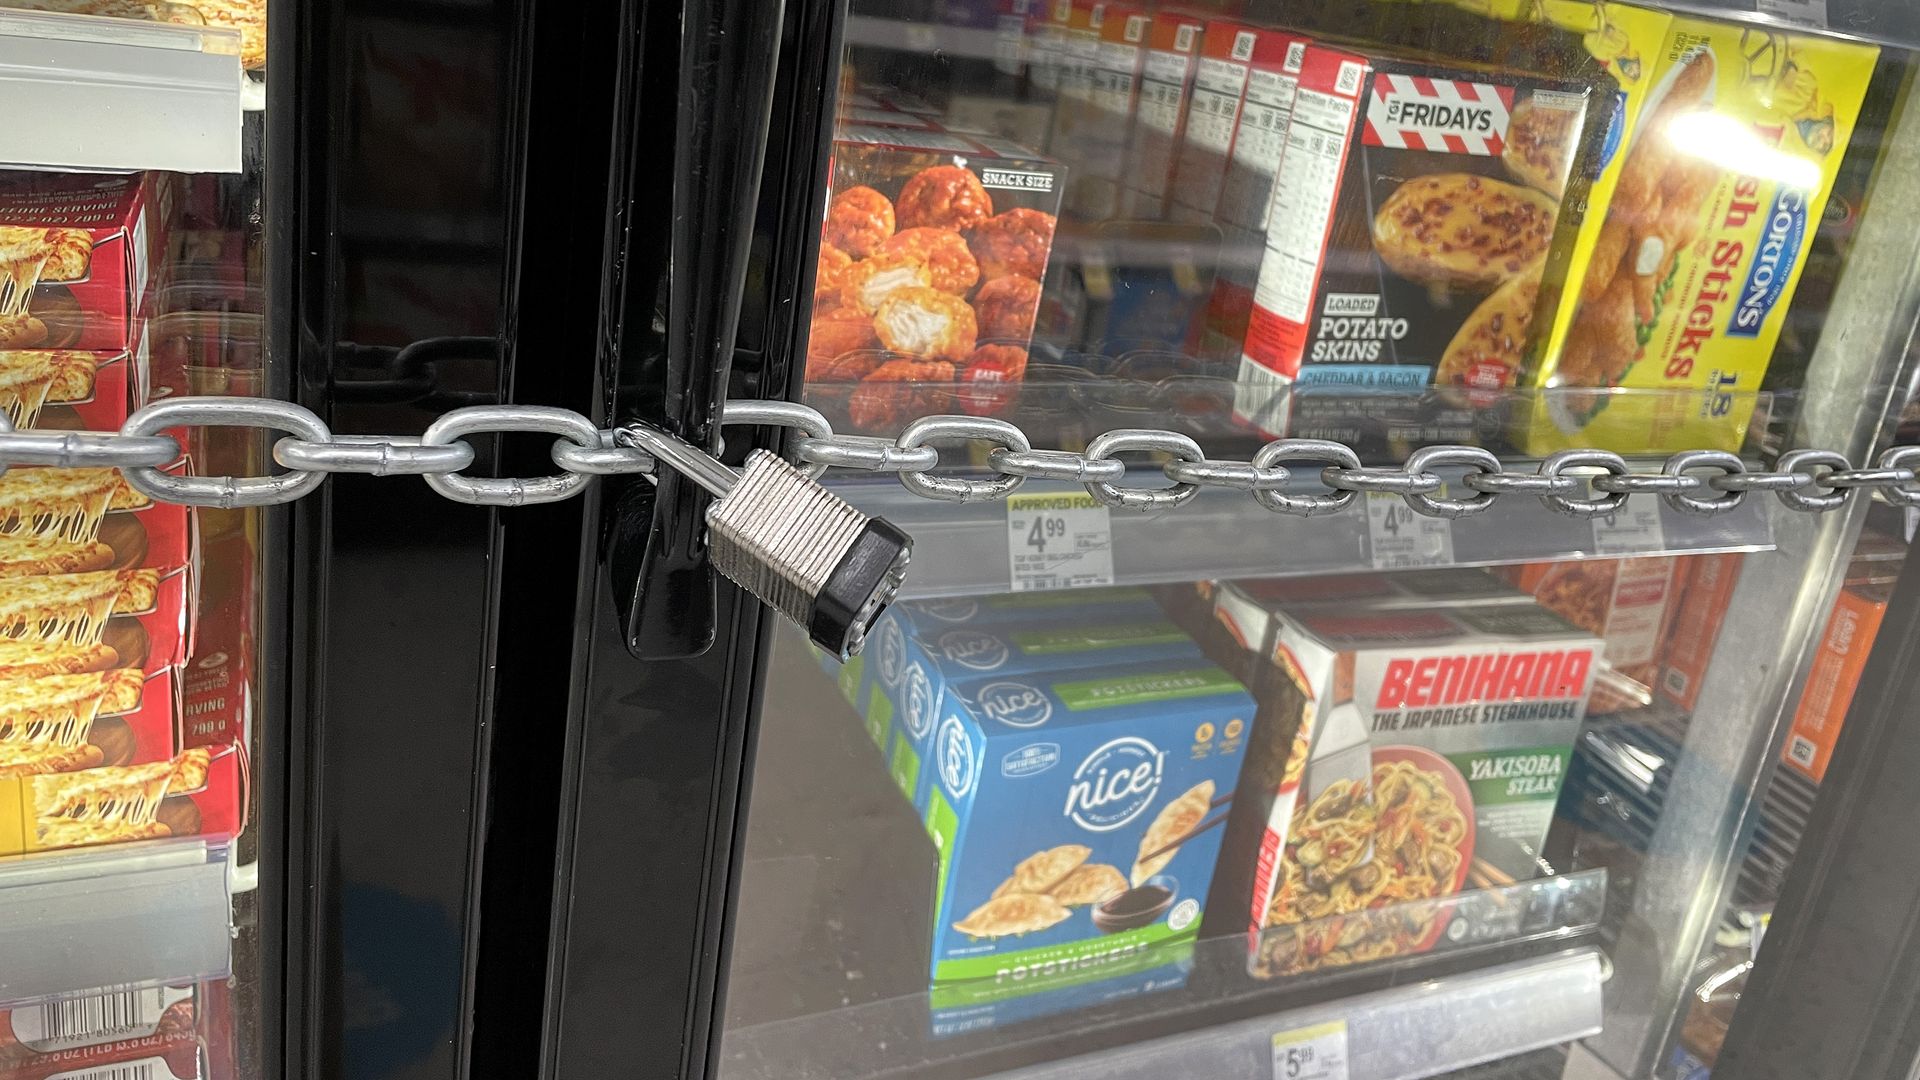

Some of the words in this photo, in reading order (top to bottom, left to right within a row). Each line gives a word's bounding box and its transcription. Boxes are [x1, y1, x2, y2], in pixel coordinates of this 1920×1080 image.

[1386, 99, 1401, 123] TGI
[1400, 101, 1492, 131] FRIDAYS
[982, 172, 1025, 186] SNACK
[1025, 175, 1053, 188] SIZE
[52, 201, 118, 213] SERVING
[1328, 297, 1376, 312] LOADED
[1664, 239, 1744, 380] Sticks
[1316, 316, 1409, 340] POTATO
[1311, 339, 1382, 361] SKINS
[1011, 497, 1072, 511] APPROVED
[1376, 650, 1592, 709] BENIHANA
[186, 697, 225, 716] RVING
[1371, 714, 1399, 731] THE
[1402, 709, 1478, 729] JAPANESE
[1483, 702, 1576, 721] STEAKHOUSE
[1469, 754, 1562, 781] YAKISOBA
[1063, 751, 1164, 816] nice!
[1506, 776, 1557, 796] STEAK
[995, 941, 1148, 984] POTSTICKERS
